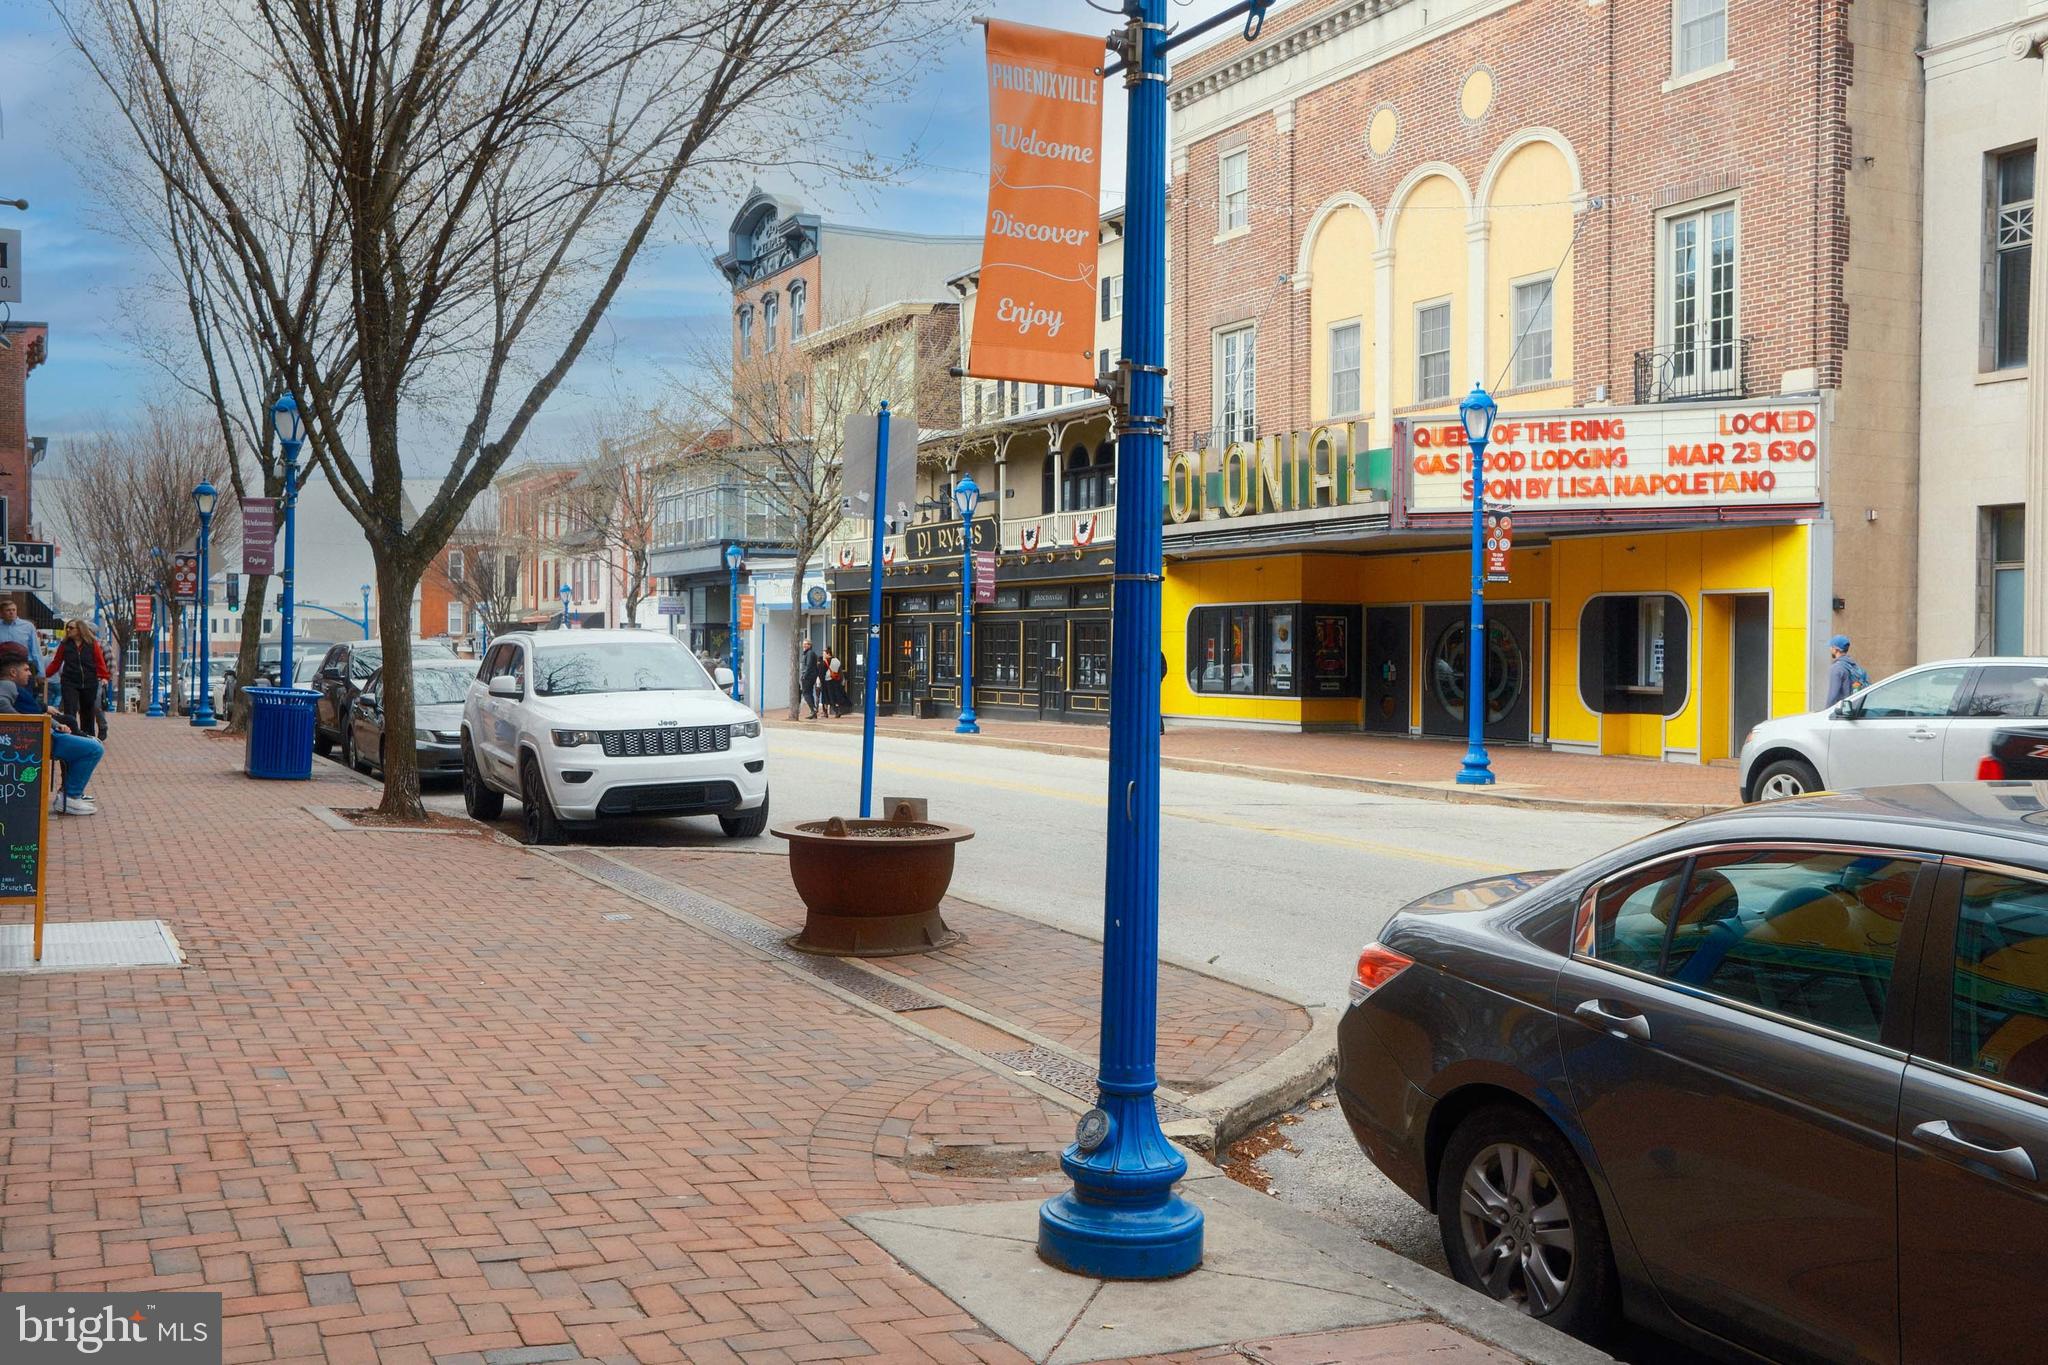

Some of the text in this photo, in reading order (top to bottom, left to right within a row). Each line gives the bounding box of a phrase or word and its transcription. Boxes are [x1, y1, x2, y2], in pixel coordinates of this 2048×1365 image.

[991, 63, 1098, 105] PHOENIXVILLE
[996, 123, 1095, 163] Welcome
[992, 209, 1089, 246] Discover
[997, 297, 1064, 337] Enjoy
[1414, 418, 1625, 448] QUEE OF THE RING
[1719, 410, 1816, 436] LOCKED
[1413, 453, 1460, 475] GAS
[1531, 447, 1628, 471] LODGING
[1668, 440, 1816, 467] MAR 23 630
[1169, 421, 1373, 524] OLONIAL
[1463, 470, 1776, 501] SON BY LISA NAPOLETANO
[4, 545, 48, 565] Rebel
[248, 556, 267, 565] Enjoy
[3, 568, 47, 589] Hill
[658, 719, 678, 727] Jeep
